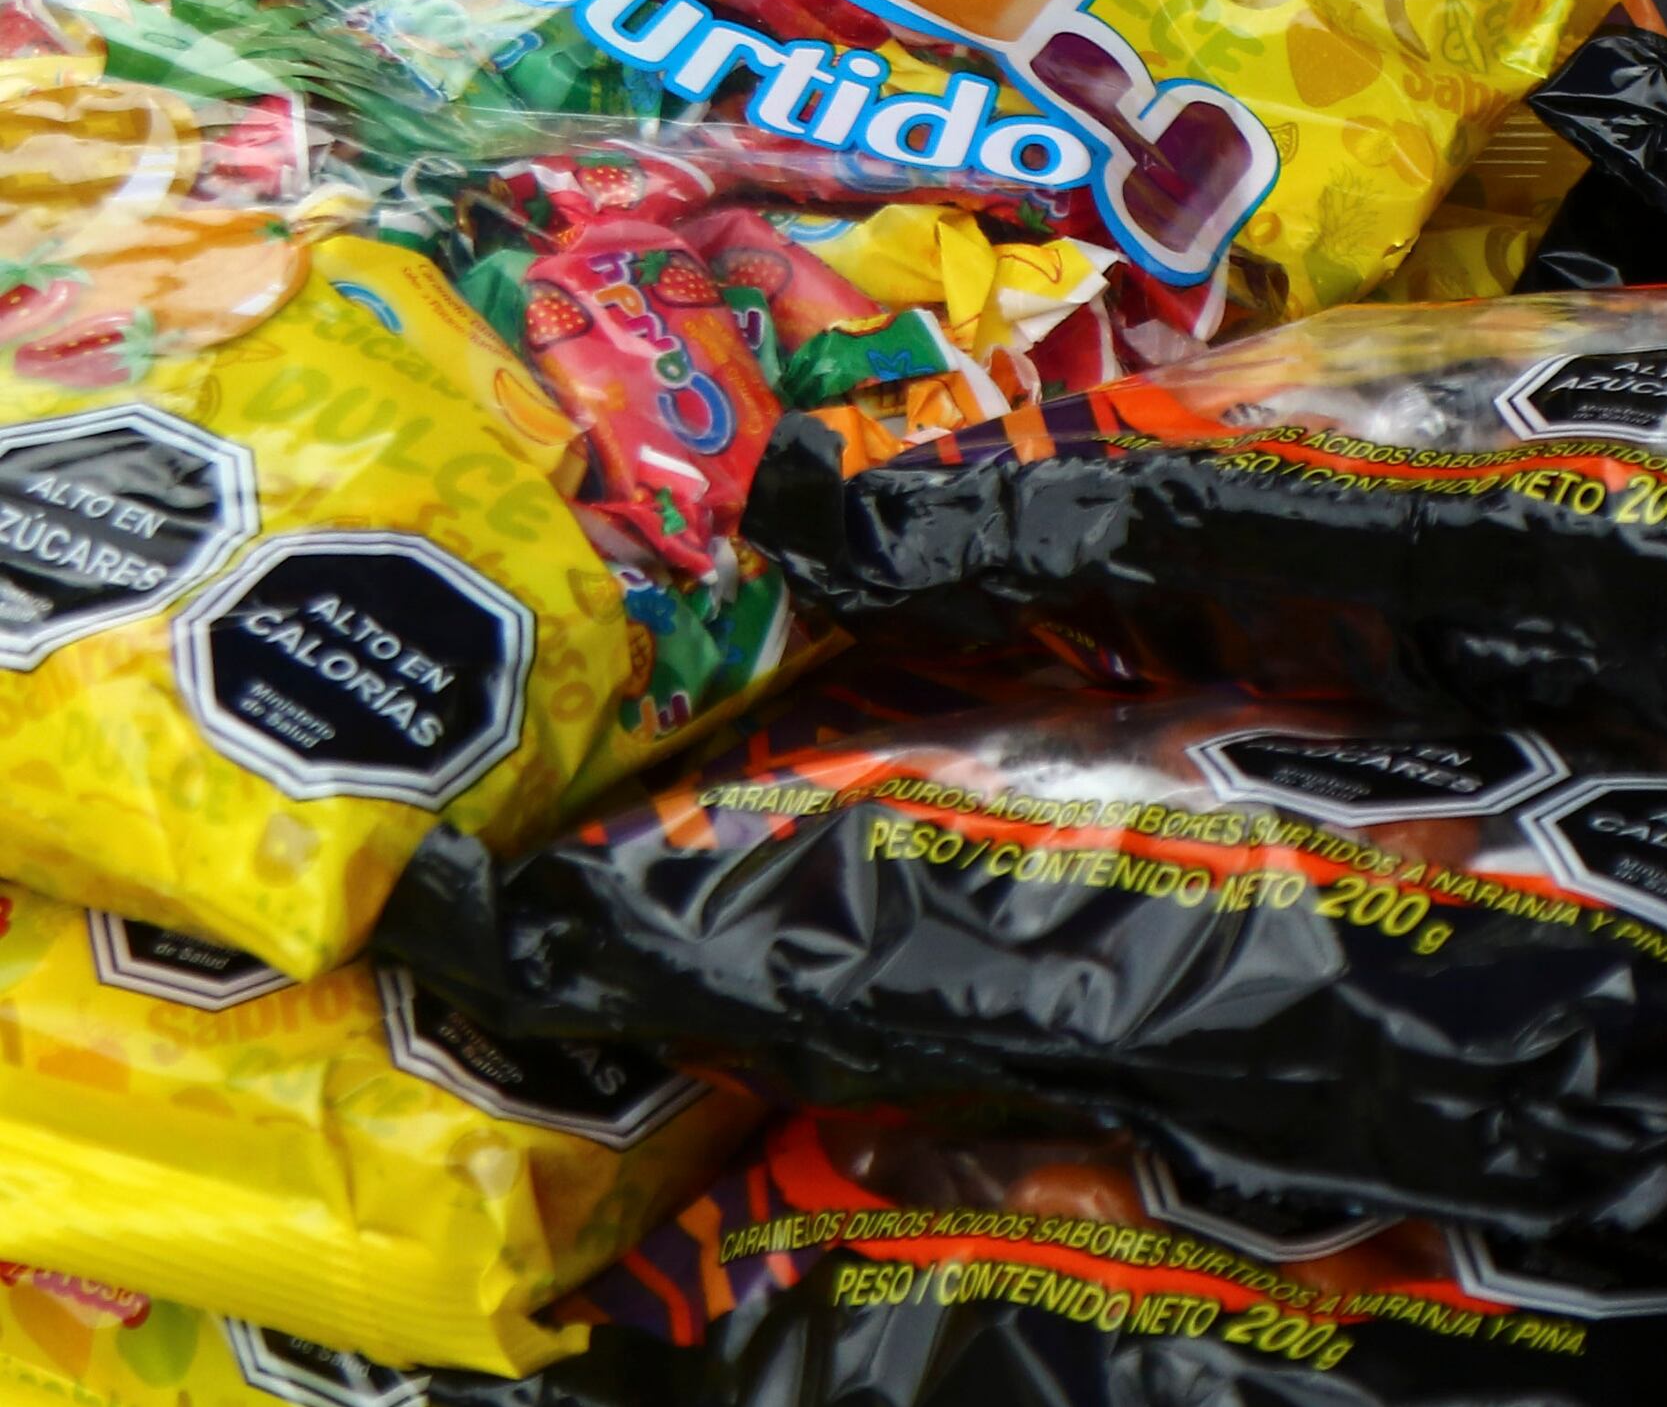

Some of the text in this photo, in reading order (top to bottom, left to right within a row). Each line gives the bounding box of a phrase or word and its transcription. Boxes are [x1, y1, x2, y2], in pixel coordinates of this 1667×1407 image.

[1303, 428, 1413, 467] ÁCIDOS
[1410, 445, 1543, 471] SABORES
[1500, 469, 1608, 515] NETO
[0, 505, 171, 593] ZÚCARES
[27, 475, 169, 540] ALTO EN
[243, 607, 447, 749] CALORÍAS
[307, 593, 458, 695] ALTO EN
[700, 777, 1615, 932] CARAMEL DUROS ÁCIDOS SABORES SURTIDOS A NARANJA Y
[867, 816, 965, 864] PESO
[988, 843, 1211, 908] CONTENIDO
[1216, 868, 1306, 915] NETO
[1314, 875, 1430, 938] 200
[1412, 922, 1455, 956] g
[719, 1211, 843, 1265] CARAMELOS
[842, 1209, 929, 1242] DUROS
[931, 1207, 1034, 1240] ÁCIDOS
[1033, 1214, 1170, 1267] SABORES
[1170, 1238, 1318, 1311] SURTIDOS
[1314, 1294, 1338, 1316] A
[1344, 1292, 1484, 1341] NARANJA
[1486, 1313, 1512, 1335] Y
[833, 1261, 914, 1308] PESO
[937, 1260, 1131, 1332] CONTENIDO
[1131, 1295, 1222, 1339] NETO
[1224, 1302, 1339, 1361] 200
[1313, 1336, 1355, 1372] g
